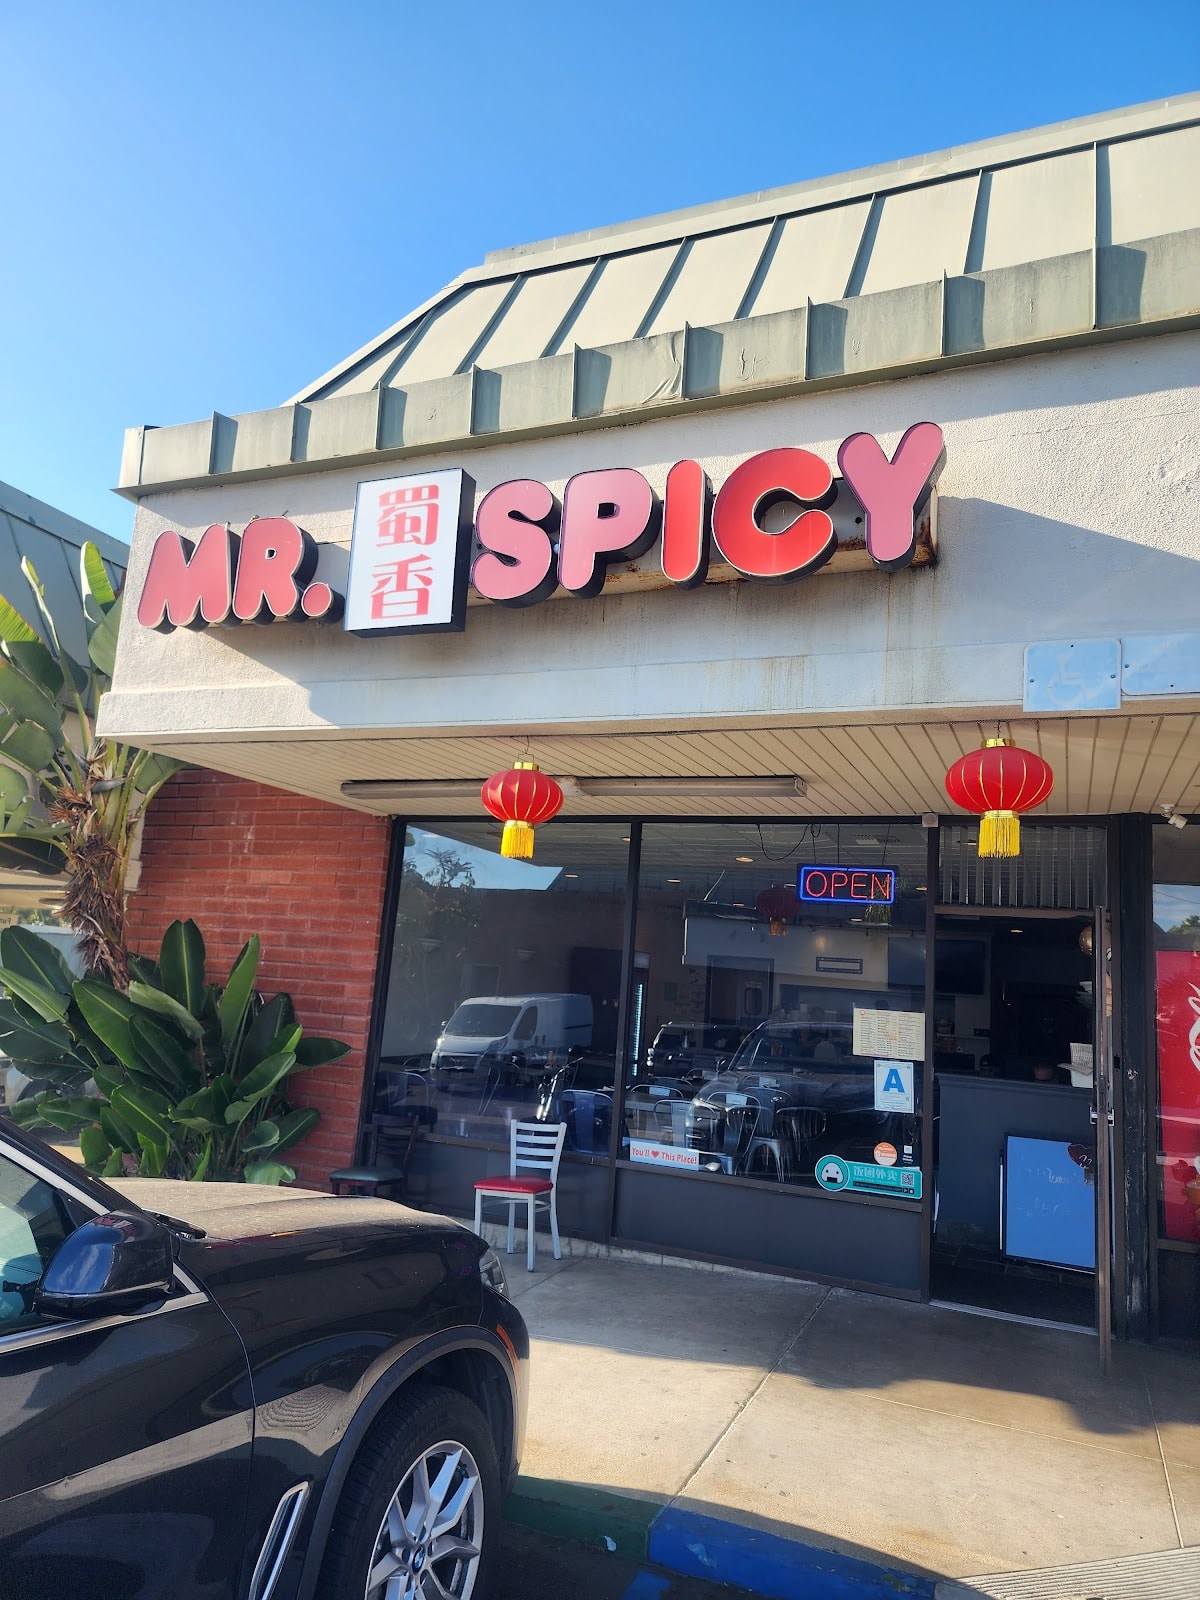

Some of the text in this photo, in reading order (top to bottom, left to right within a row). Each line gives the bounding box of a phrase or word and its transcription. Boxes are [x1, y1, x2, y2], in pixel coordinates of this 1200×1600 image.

[137, 421, 945, 630] MR. SPICY
[370, 483, 440, 620] 蜀香
[805, 870, 892, 900] OPEN
[883, 1068, 905, 1093] A
[631, 1147, 697, 1165] You'll This Place!
[853, 1165, 898, 1181] 饭团外卖
